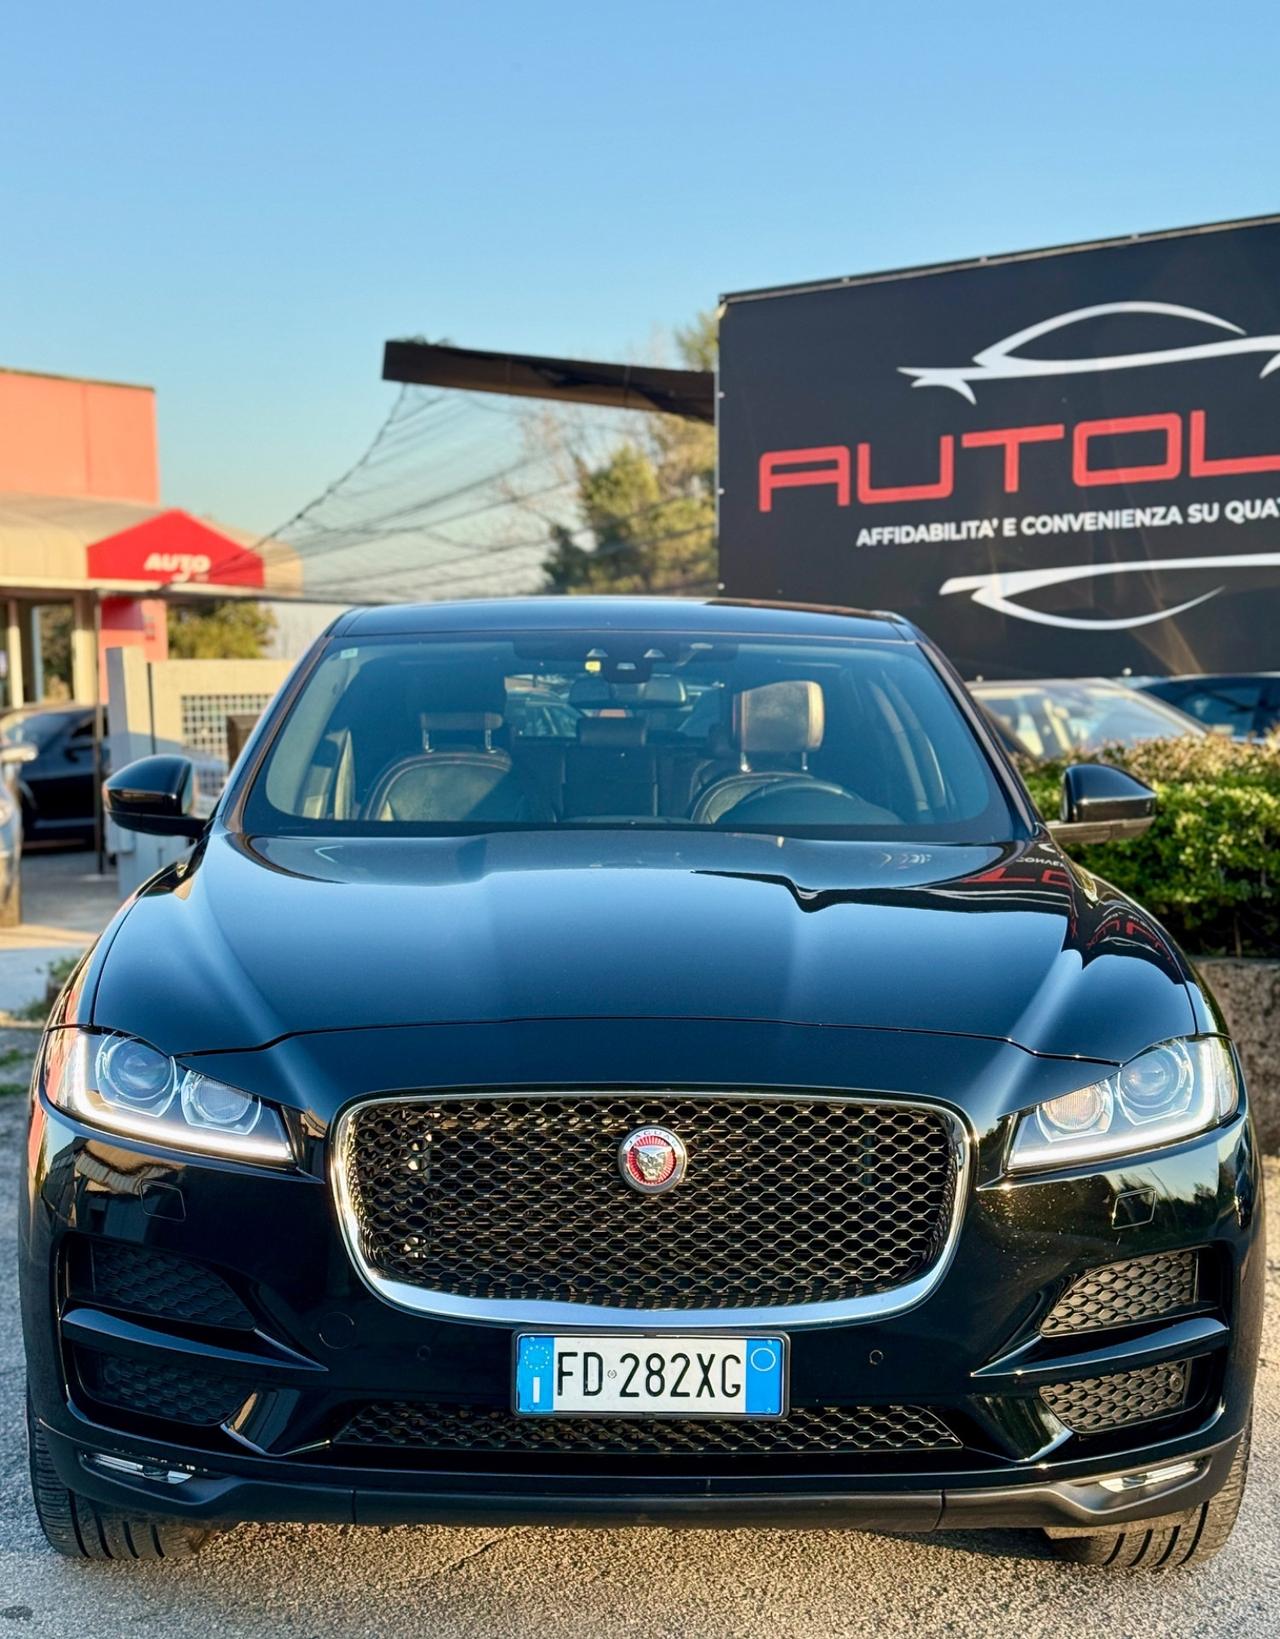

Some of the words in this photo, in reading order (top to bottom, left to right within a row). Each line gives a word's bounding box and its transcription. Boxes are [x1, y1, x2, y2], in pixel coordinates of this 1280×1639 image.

[759, 410, 1280, 512] AUTOL
[1003, 517, 1017, 537] E
[1021, 505, 1183, 536] CONVENIENZA
[1187, 502, 1220, 524] SU
[1224, 497, 1280, 524] QUA
[143, 552, 212, 583] AUTO
[557, 1351, 603, 1396] FD
[619, 1352, 742, 1398] 282XG
